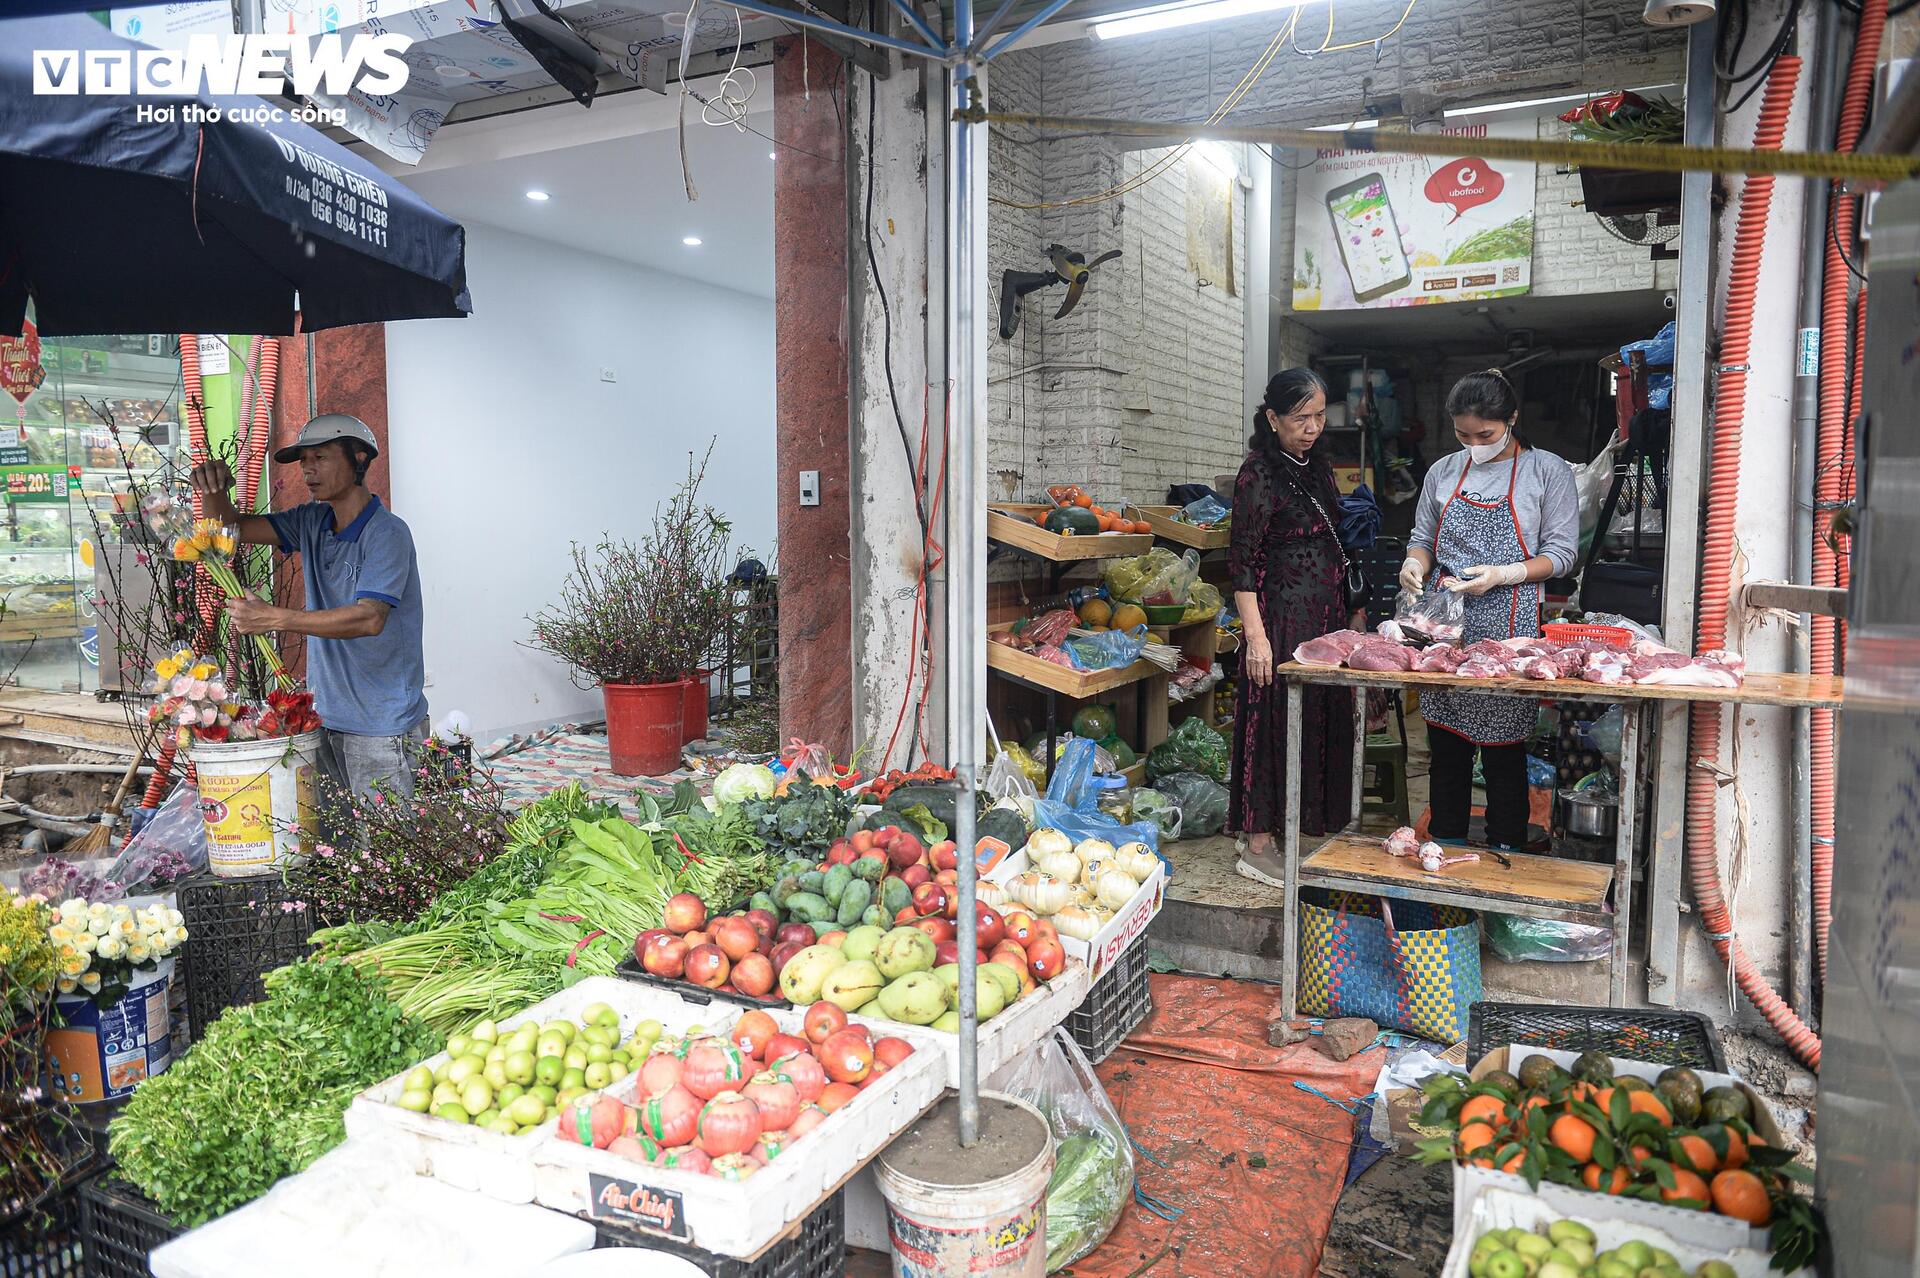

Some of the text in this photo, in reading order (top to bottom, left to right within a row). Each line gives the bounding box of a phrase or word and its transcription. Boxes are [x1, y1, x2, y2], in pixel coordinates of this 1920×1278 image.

[1367, 159, 1376, 167] 40
[311, 199, 388, 248] 056 994 1111
[312, 177, 334, 203] 036
[336, 190, 358, 215] 430
[360, 201, 388, 229] 1038
